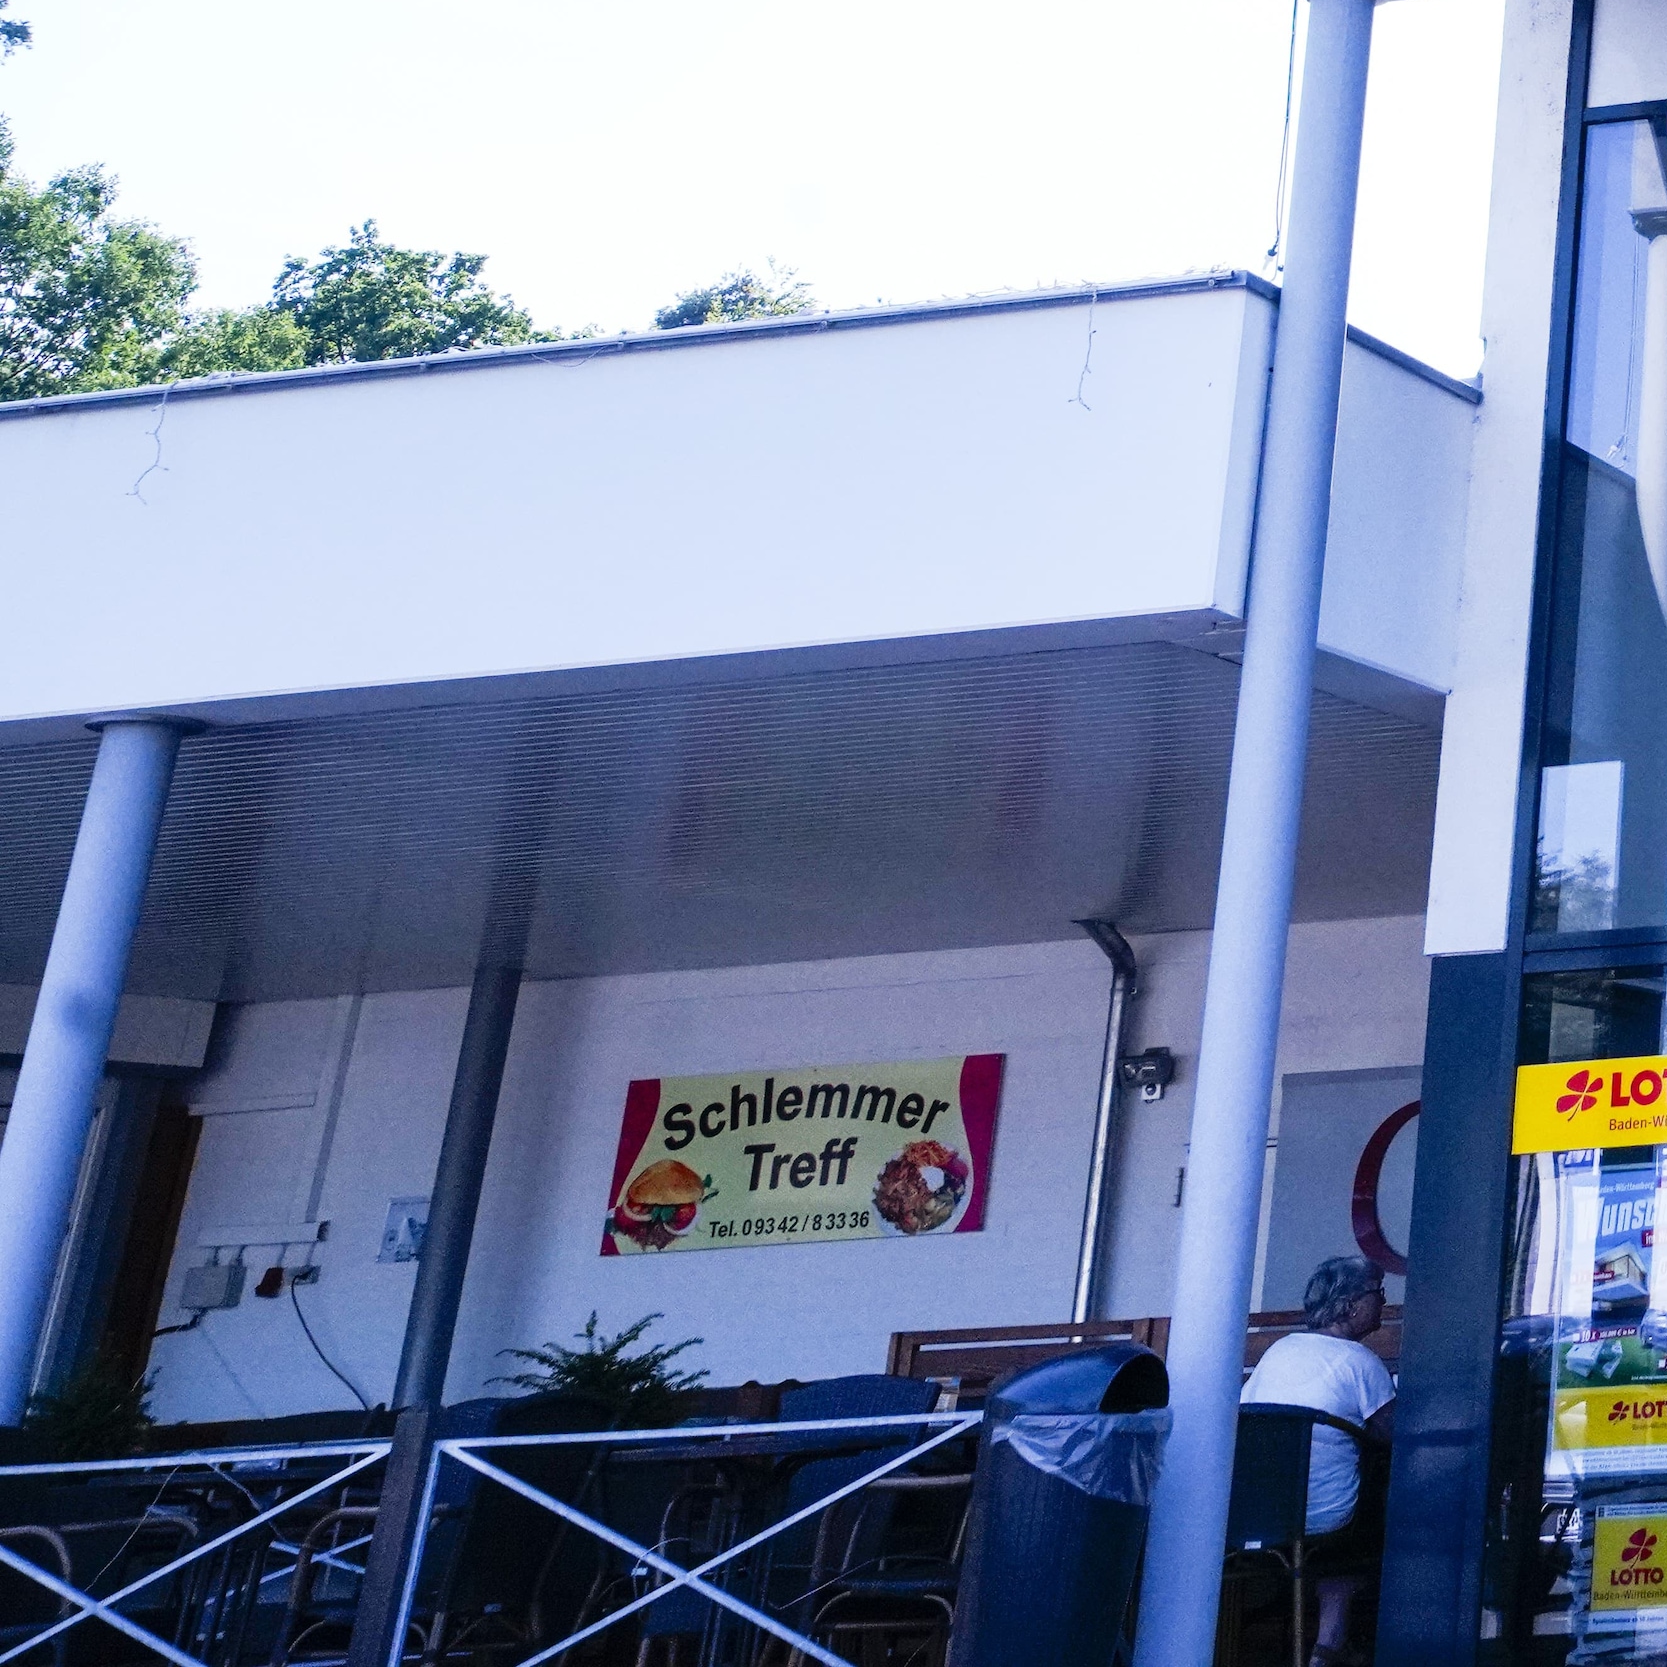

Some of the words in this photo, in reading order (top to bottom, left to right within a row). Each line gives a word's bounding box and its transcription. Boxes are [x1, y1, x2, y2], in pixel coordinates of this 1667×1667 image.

[663, 1078, 950, 1151] Schlemmer
[743, 1136, 858, 1192] Treff
[708, 1219, 738, 1239] Tel.
[1610, 1567, 1664, 1586] LOTTO
